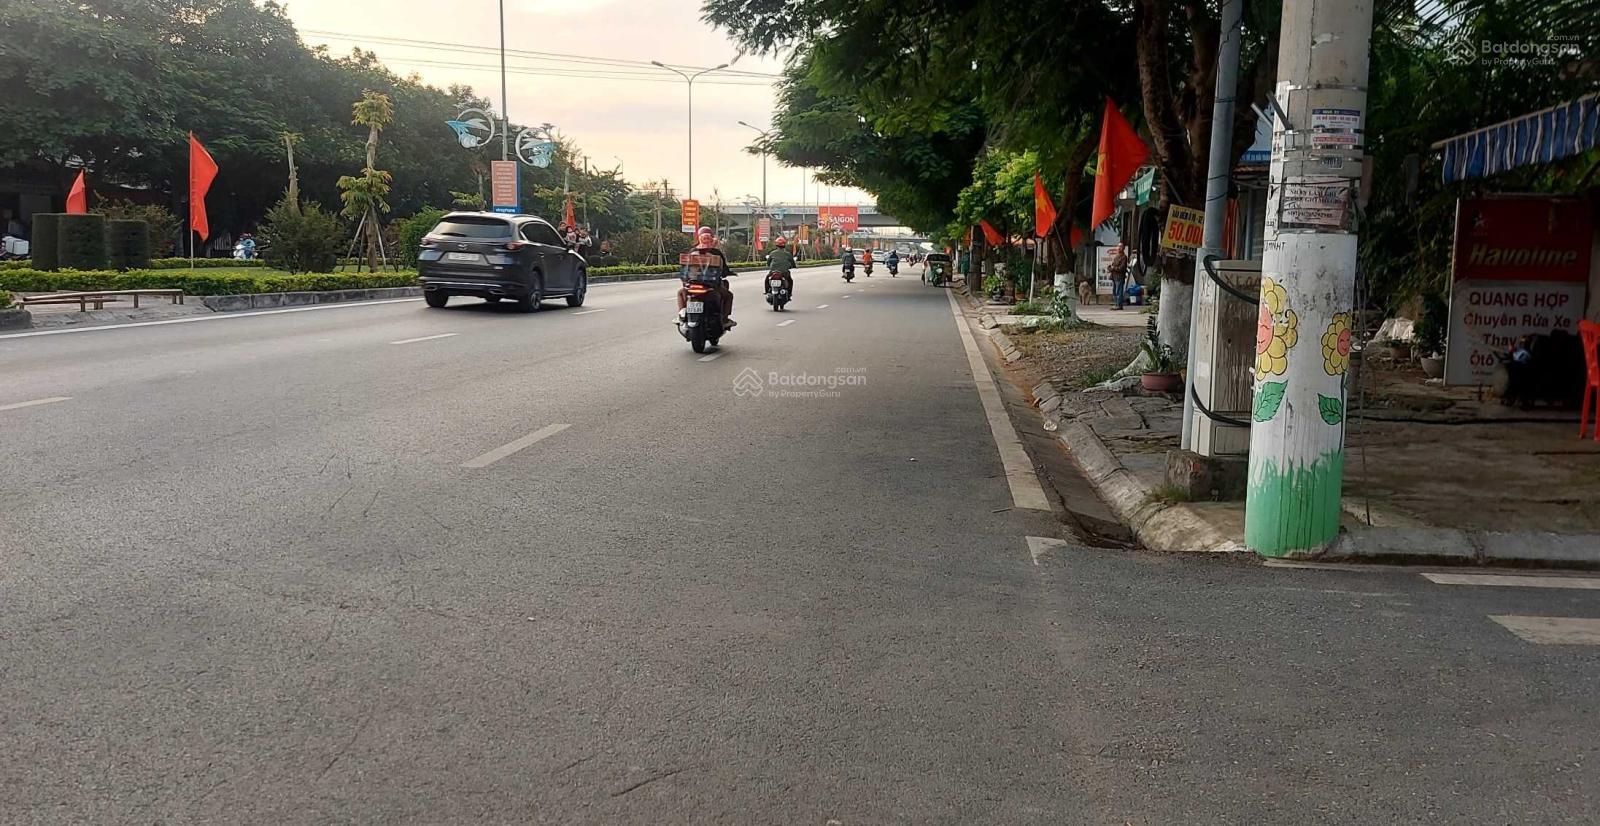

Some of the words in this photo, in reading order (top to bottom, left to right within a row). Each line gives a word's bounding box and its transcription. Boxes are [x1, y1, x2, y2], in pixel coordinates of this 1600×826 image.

[829, 215, 855, 223] SAIGON
[1468, 242, 1578, 268] Havoline
[1469, 291, 1528, 307] QUANG
[1534, 290, 1569, 310] HỢP
[1463, 312, 1517, 329] Chuyên
[1522, 312, 1549, 327] Rửa
[1553, 314, 1571, 328] Xe
[1483, 333, 1517, 348] Thay
